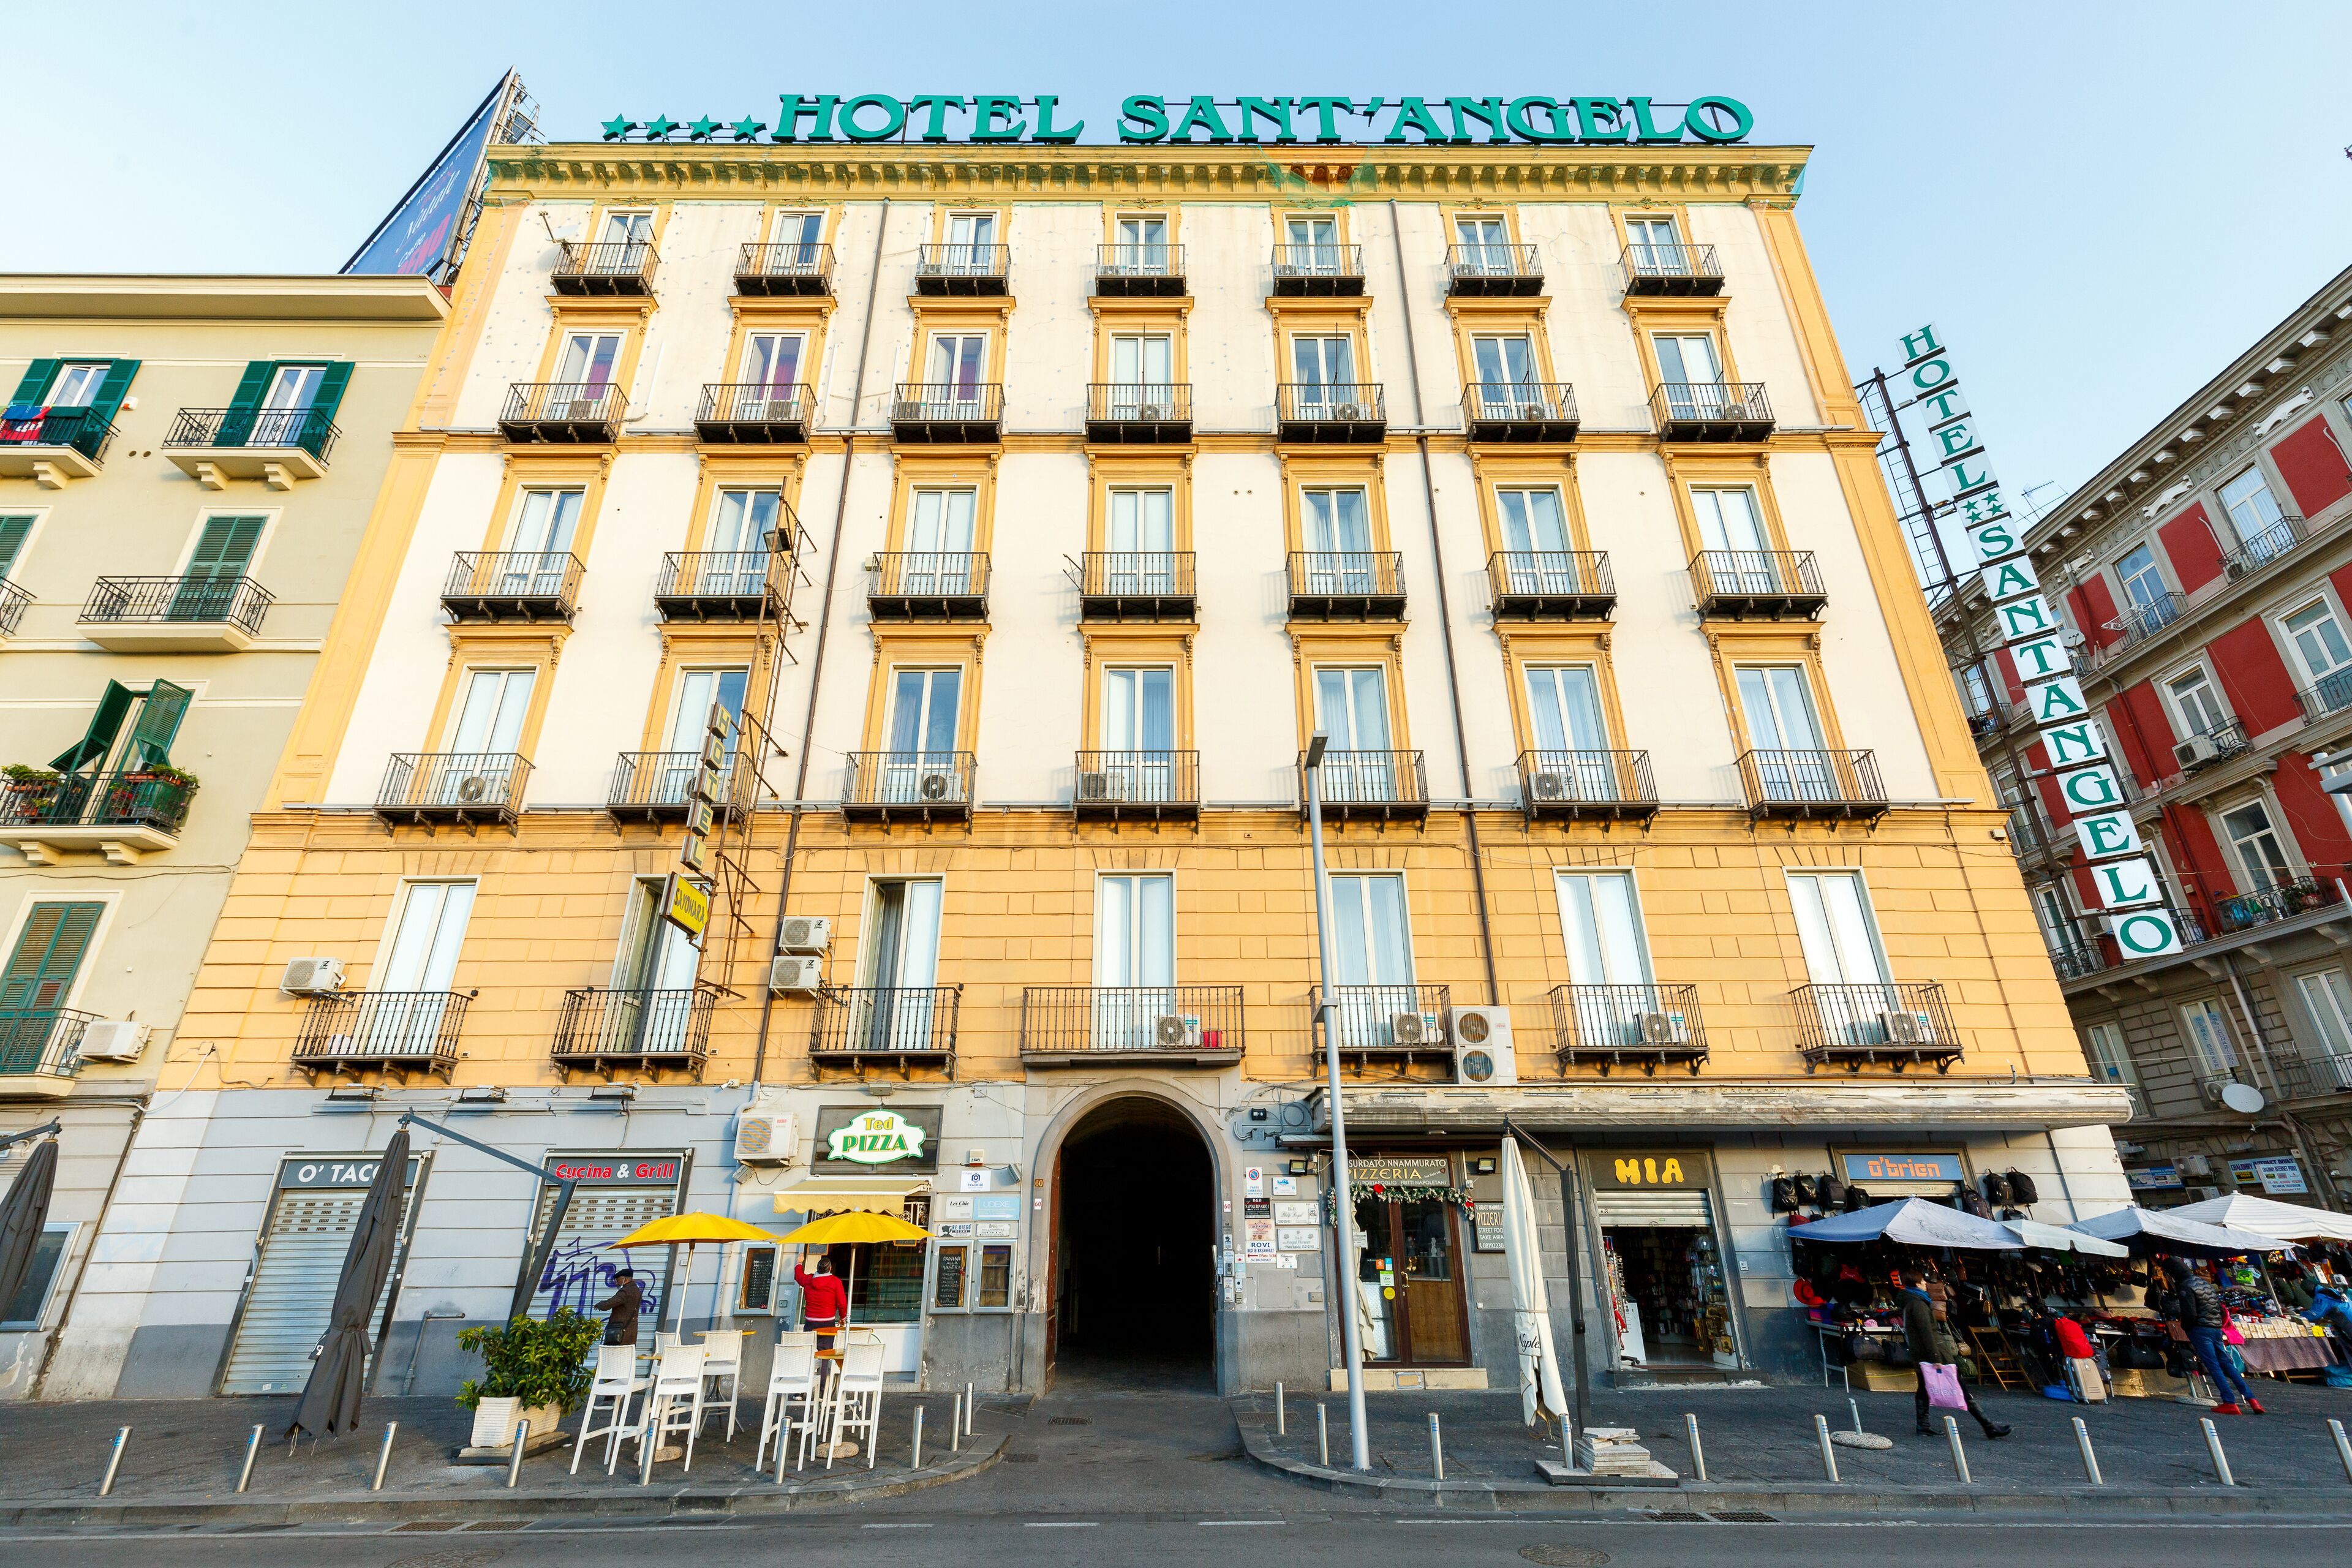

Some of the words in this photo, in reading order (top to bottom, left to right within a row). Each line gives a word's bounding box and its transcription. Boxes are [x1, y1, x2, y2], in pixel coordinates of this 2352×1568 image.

[771, 94, 1085, 144] HOTEL
[1117, 95, 1754, 145] SANT'ANGELO
[1899, 325, 1986, 491] HOTEL
[693, 714, 730, 868] HOTEL
[2196, 1017, 2209, 1041] GLOBAL
[2206, 1044, 2220, 1068] BROKER
[2212, 1014, 2234, 1065] ASSICURAZIONI
[842, 1134, 908, 1153] PIZZA
[863, 1117, 894, 1131] Ted
[555, 1163, 612, 1179] Cucina
[617, 1163, 630, 1178] &
[635, 1162, 675, 1179] Grill
[1348, 1159, 1385, 1167] SURDATO
[1387, 1159, 1446, 1167] NNAMMURATO
[1614, 1158, 1684, 1185] MIA
